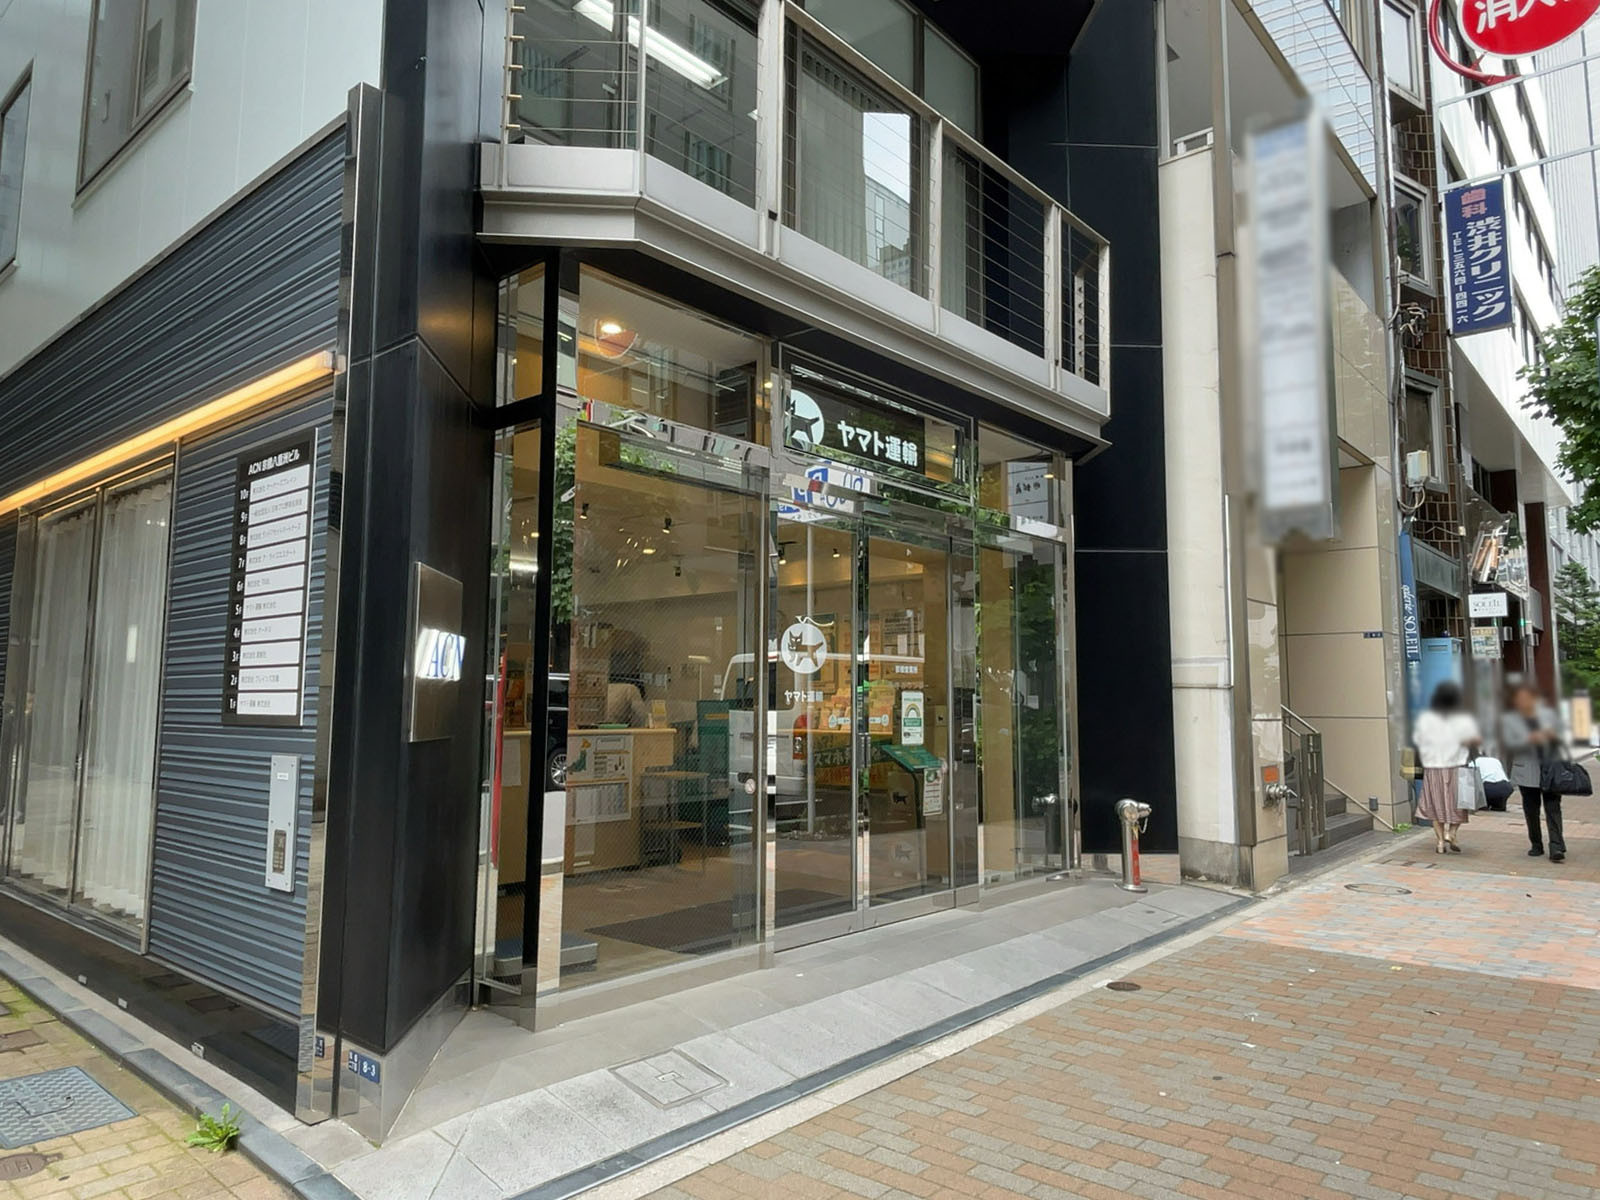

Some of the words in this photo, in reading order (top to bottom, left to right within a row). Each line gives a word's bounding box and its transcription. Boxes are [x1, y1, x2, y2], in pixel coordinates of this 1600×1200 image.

[1466, 215, 1506, 322] 渋井クリニック
[837, 420, 919, 467] ヤマト運輸
[427, 631, 466, 681] ACN
[1404, 615, 1419, 658] SOLEIL
[362, 1061, 376, 1077] 8-3
